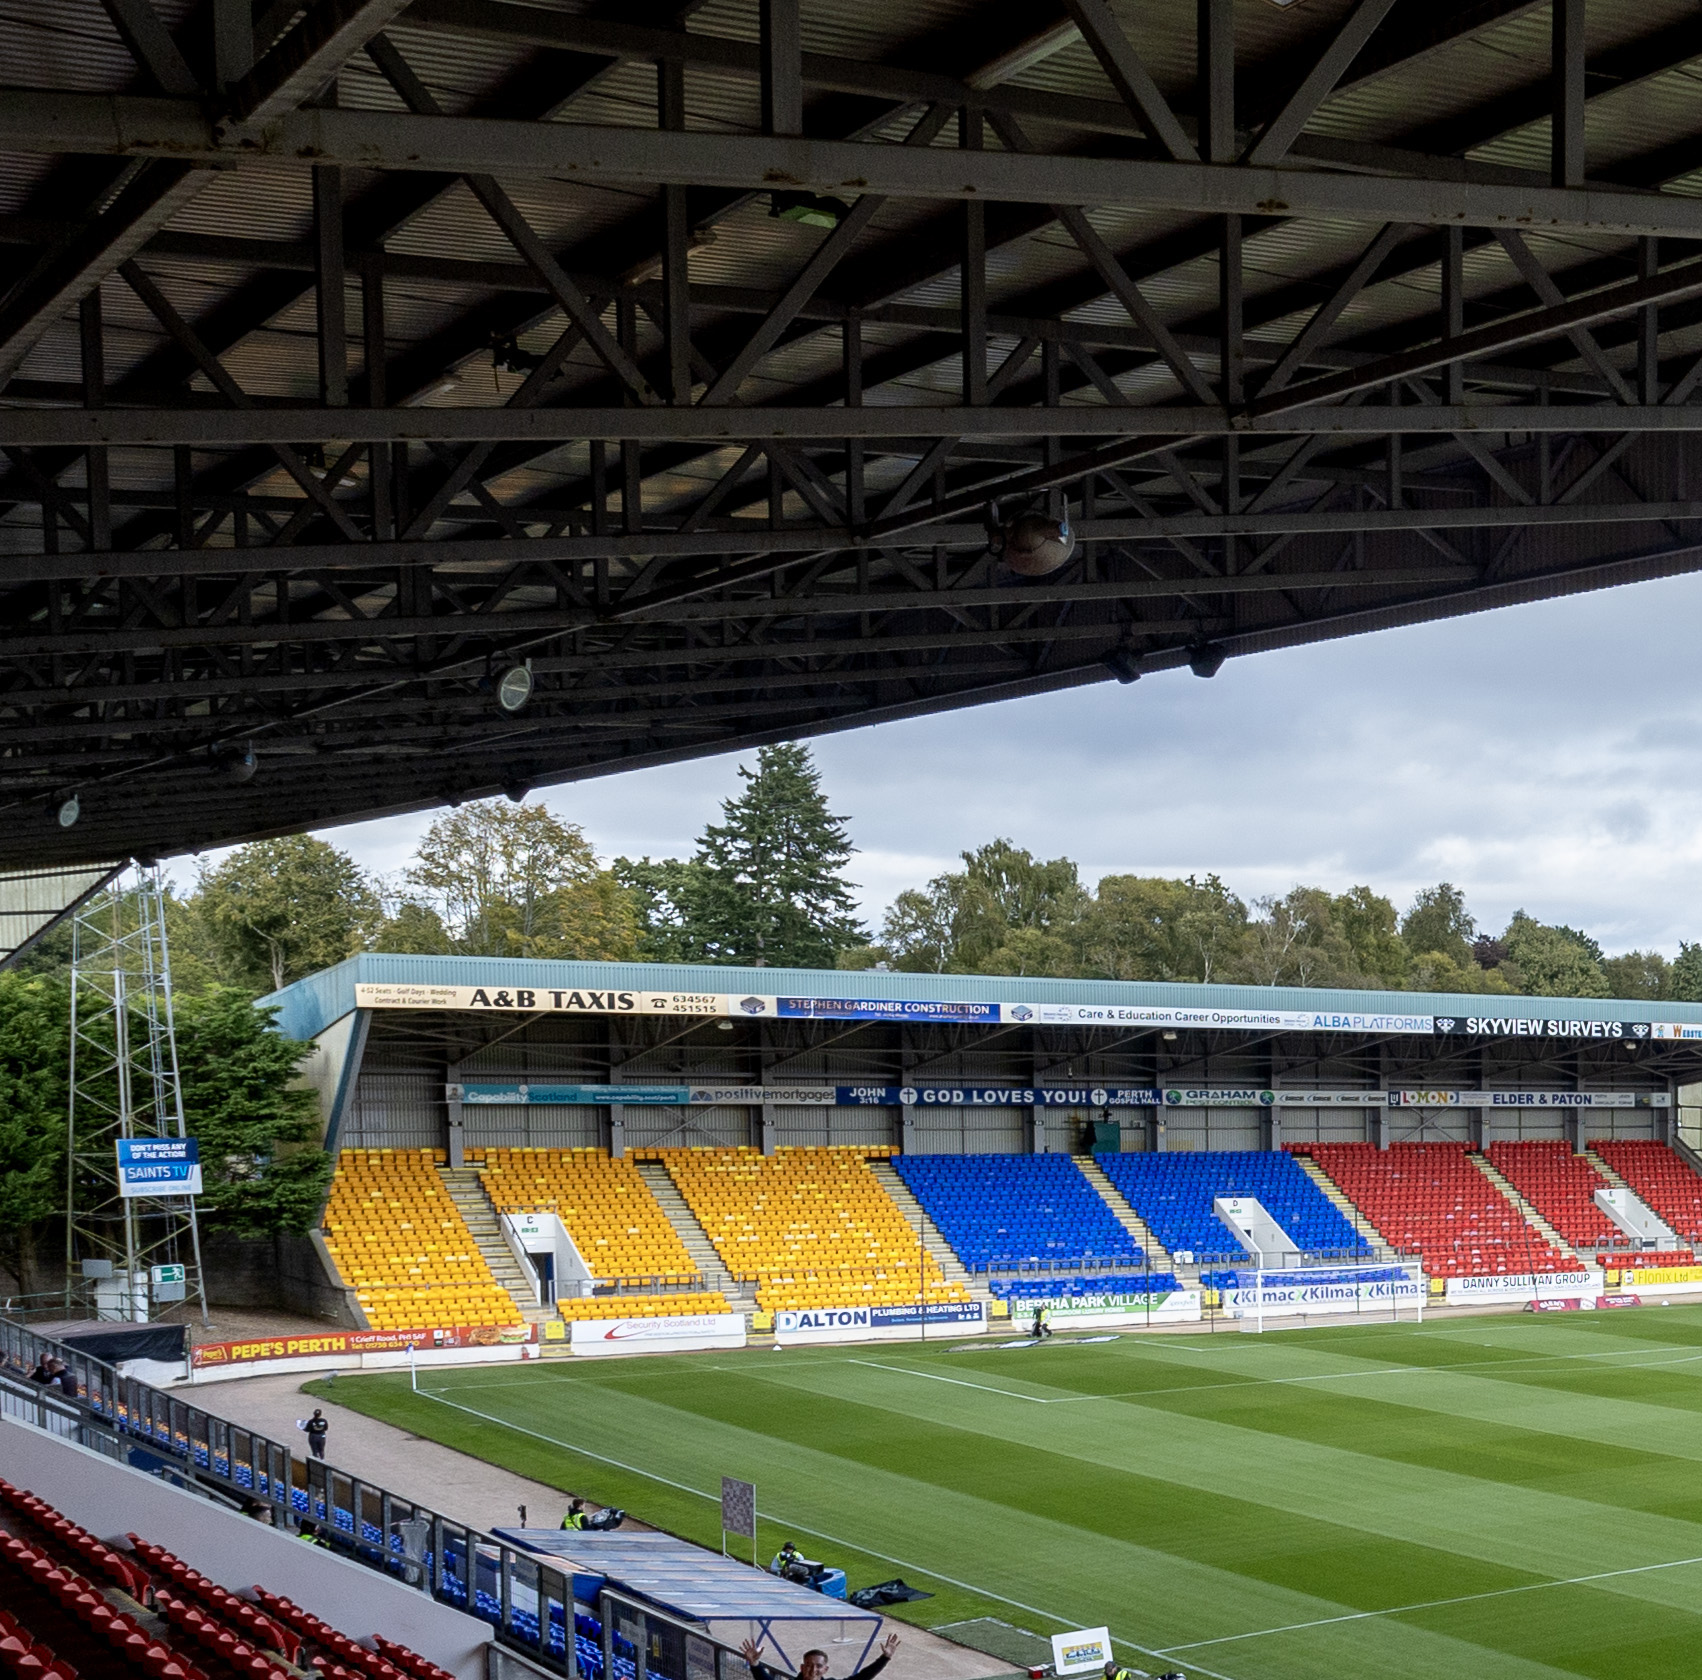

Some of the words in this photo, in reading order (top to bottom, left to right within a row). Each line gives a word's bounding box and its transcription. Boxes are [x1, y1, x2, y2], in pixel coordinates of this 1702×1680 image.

[469, 988, 536, 1008] A&B
[548, 991, 634, 1010] TAXIS
[788, 1000, 842, 1010] STEPHEN
[844, 1001, 903, 1012] GARDINER
[904, 1002, 990, 1015] CONSTRUCTION
[1078, 1009, 1103, 1019] Care
[1107, 1010, 1115, 1019] &
[1118, 1010, 1171, 1021] Education
[1174, 1011, 1209, 1022] Career
[1212, 1012, 1281, 1025] Opportunities
[1466, 1017, 1543, 1036] SKYVIEW
[1547, 1020, 1623, 1038] SURVEYS
[849, 1087, 886, 1097] JOHN
[923, 1090, 965, 1103] GOD
[972, 1090, 1035, 1103] LOVES
[1042, 1090, 1087, 1103] YOU!
[1185, 1090, 1256, 1099] GRAHAM
[1402, 1091, 1460, 1105] LOMOND
[1493, 1093, 1537, 1105] ELDER
[1538, 1094, 1548, 1105] &
[1552, 1094, 1592, 1105] PATON
[127, 1165, 171, 1180] SAINTS
[172, 1164, 188, 1177] TV
[526, 1215, 534, 1224] C
[1462, 1277, 1500, 1289] DANNY
[1502, 1275, 1553, 1288] SULLIVAN
[1555, 1273, 1591, 1286] GROUP
[1637, 1271, 1671, 1285] Flonix
[1674, 1269, 1689, 1283] Ltd
[1241, 1290, 1295, 1303] Kimac
[1310, 1286, 1361, 1300] Kilmac
[1016, 1297, 1070, 1312] BERTHA
[1071, 1295, 1107, 1309] PARK
[1108, 1292, 1158, 1307] VILLAGE
[626, 1320, 661, 1332] Security
[663, 1318, 701, 1328] Scotland
[702, 1318, 716, 1326] Ltd
[778, 1311, 869, 1332] DALTON
[231, 1342, 285, 1360] PEPE'S
[287, 1337, 346, 1353] PERTH
